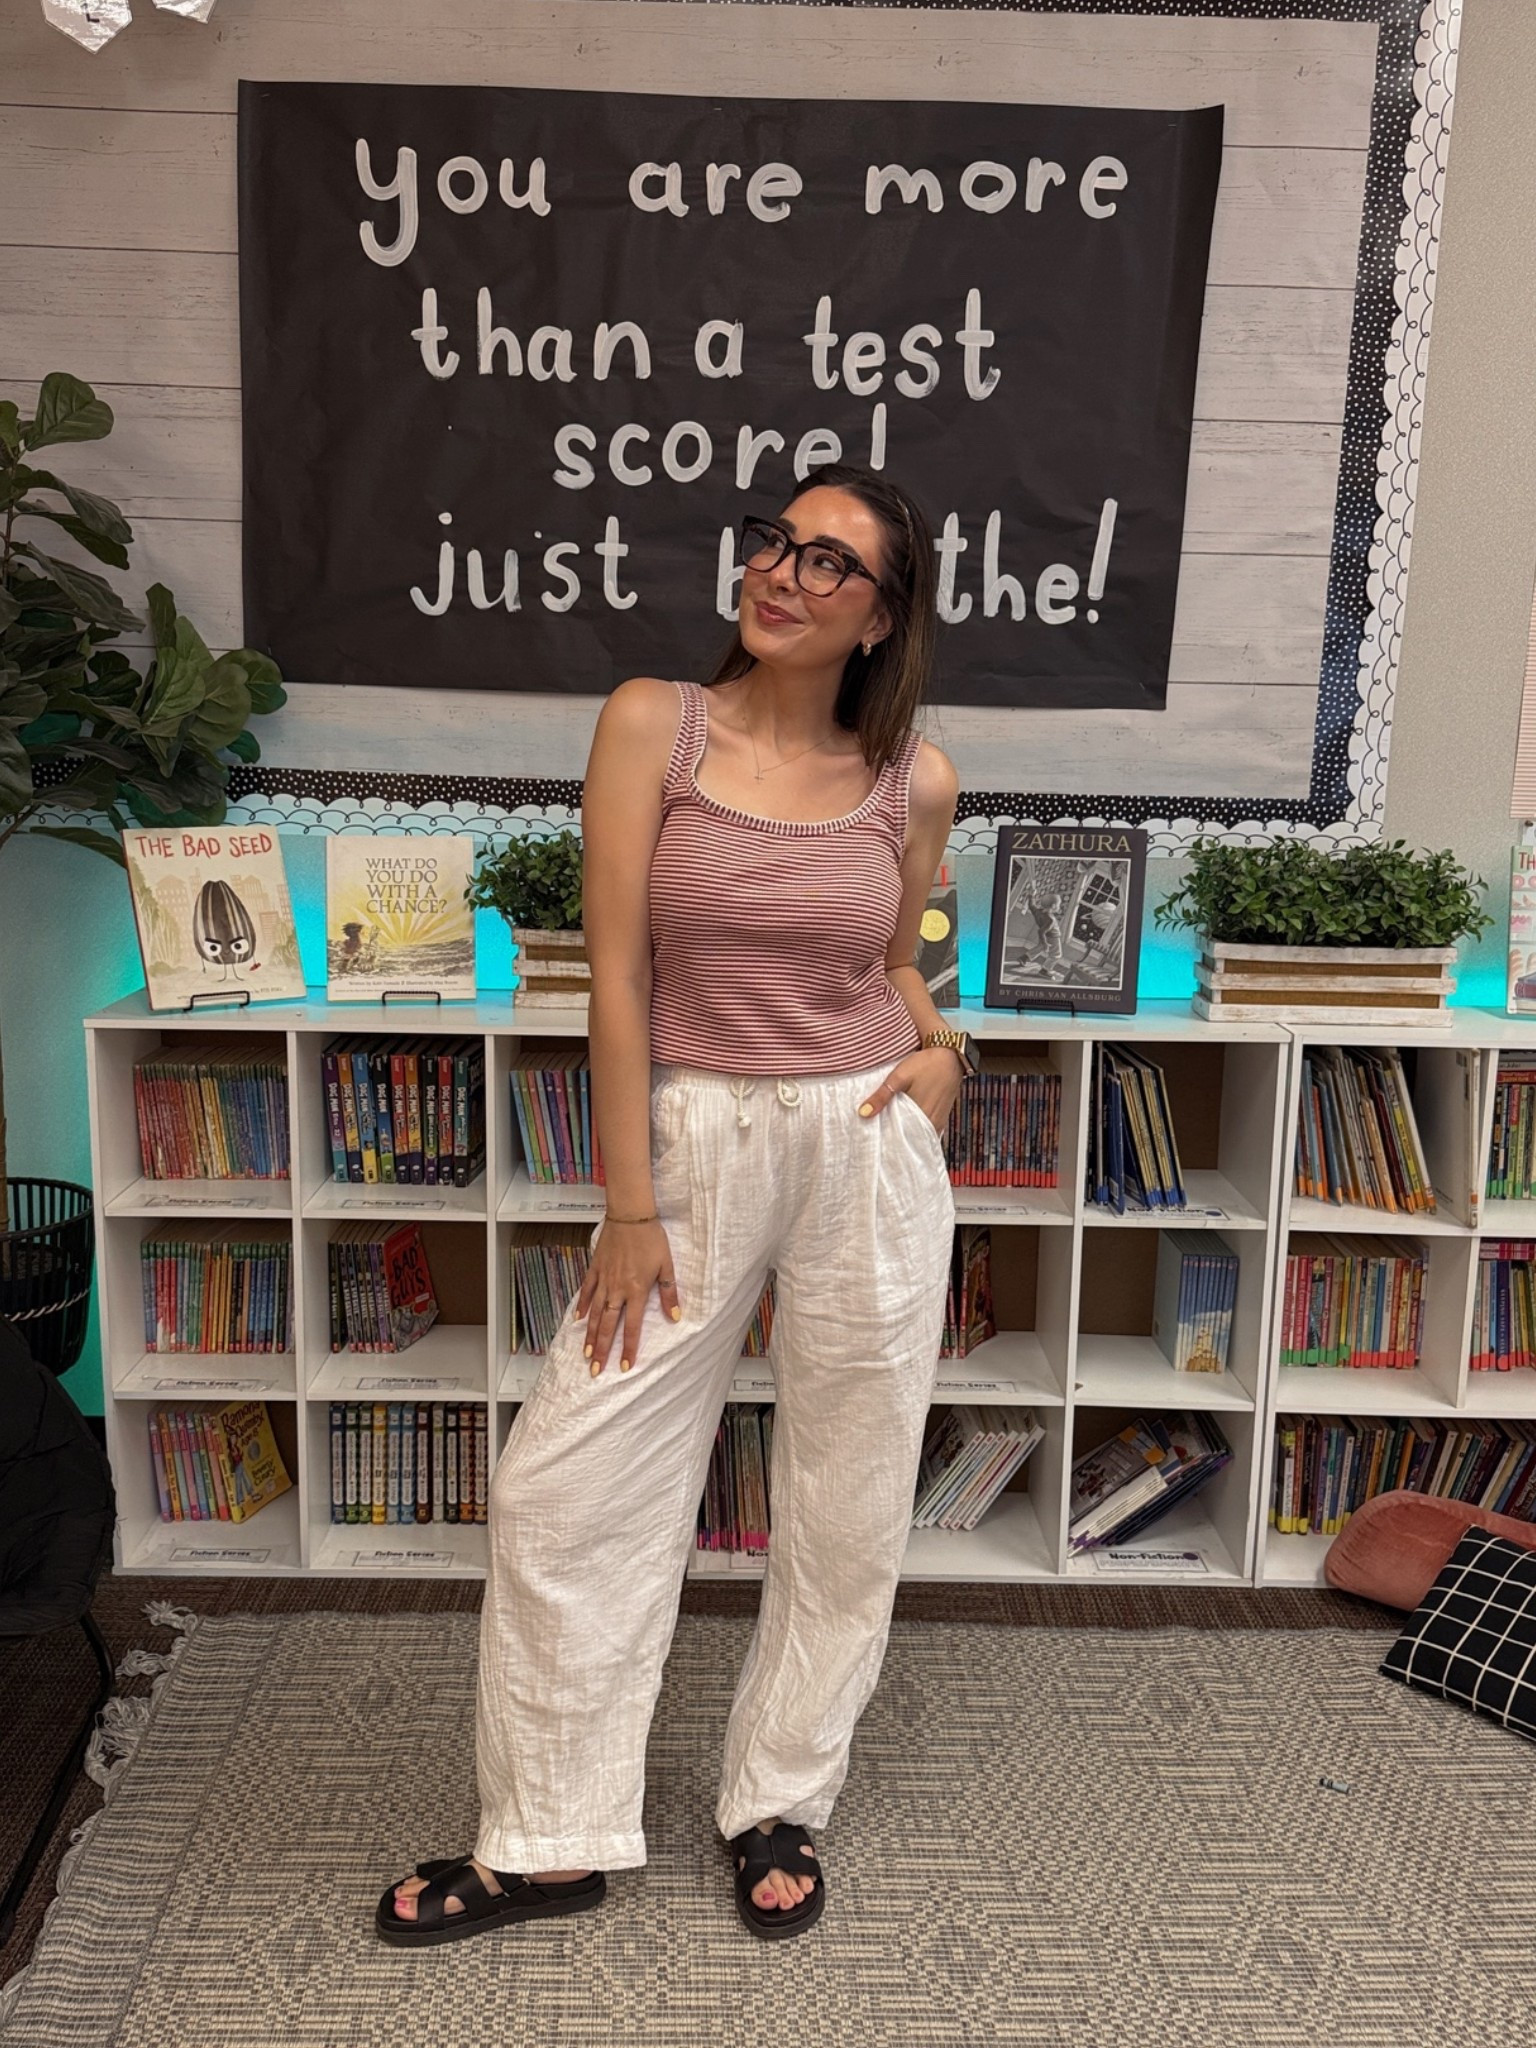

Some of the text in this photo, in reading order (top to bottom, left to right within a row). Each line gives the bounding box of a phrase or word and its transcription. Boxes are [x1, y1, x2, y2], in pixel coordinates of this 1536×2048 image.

[356, 139, 1127, 266] you are more
[411, 287, 1001, 400] than a test
[554, 403, 886, 494] score!
[410, 498, 1117, 624] just bthe!
[134, 832, 273, 859] THE BAD SEED
[1011, 832, 1132, 853] ZATHURA
[366, 857, 437, 869] WHAT DO
[366, 869, 438, 884] YOU DO
[366, 884, 437, 899] WITH A
[366, 899, 448, 914] CHANCE?
[999, 989, 1121, 1002] BY CHRIS VAN ALLSBURG
[392, 1246, 418, 1282] BAD
[391, 1267, 427, 1310] GUYS
